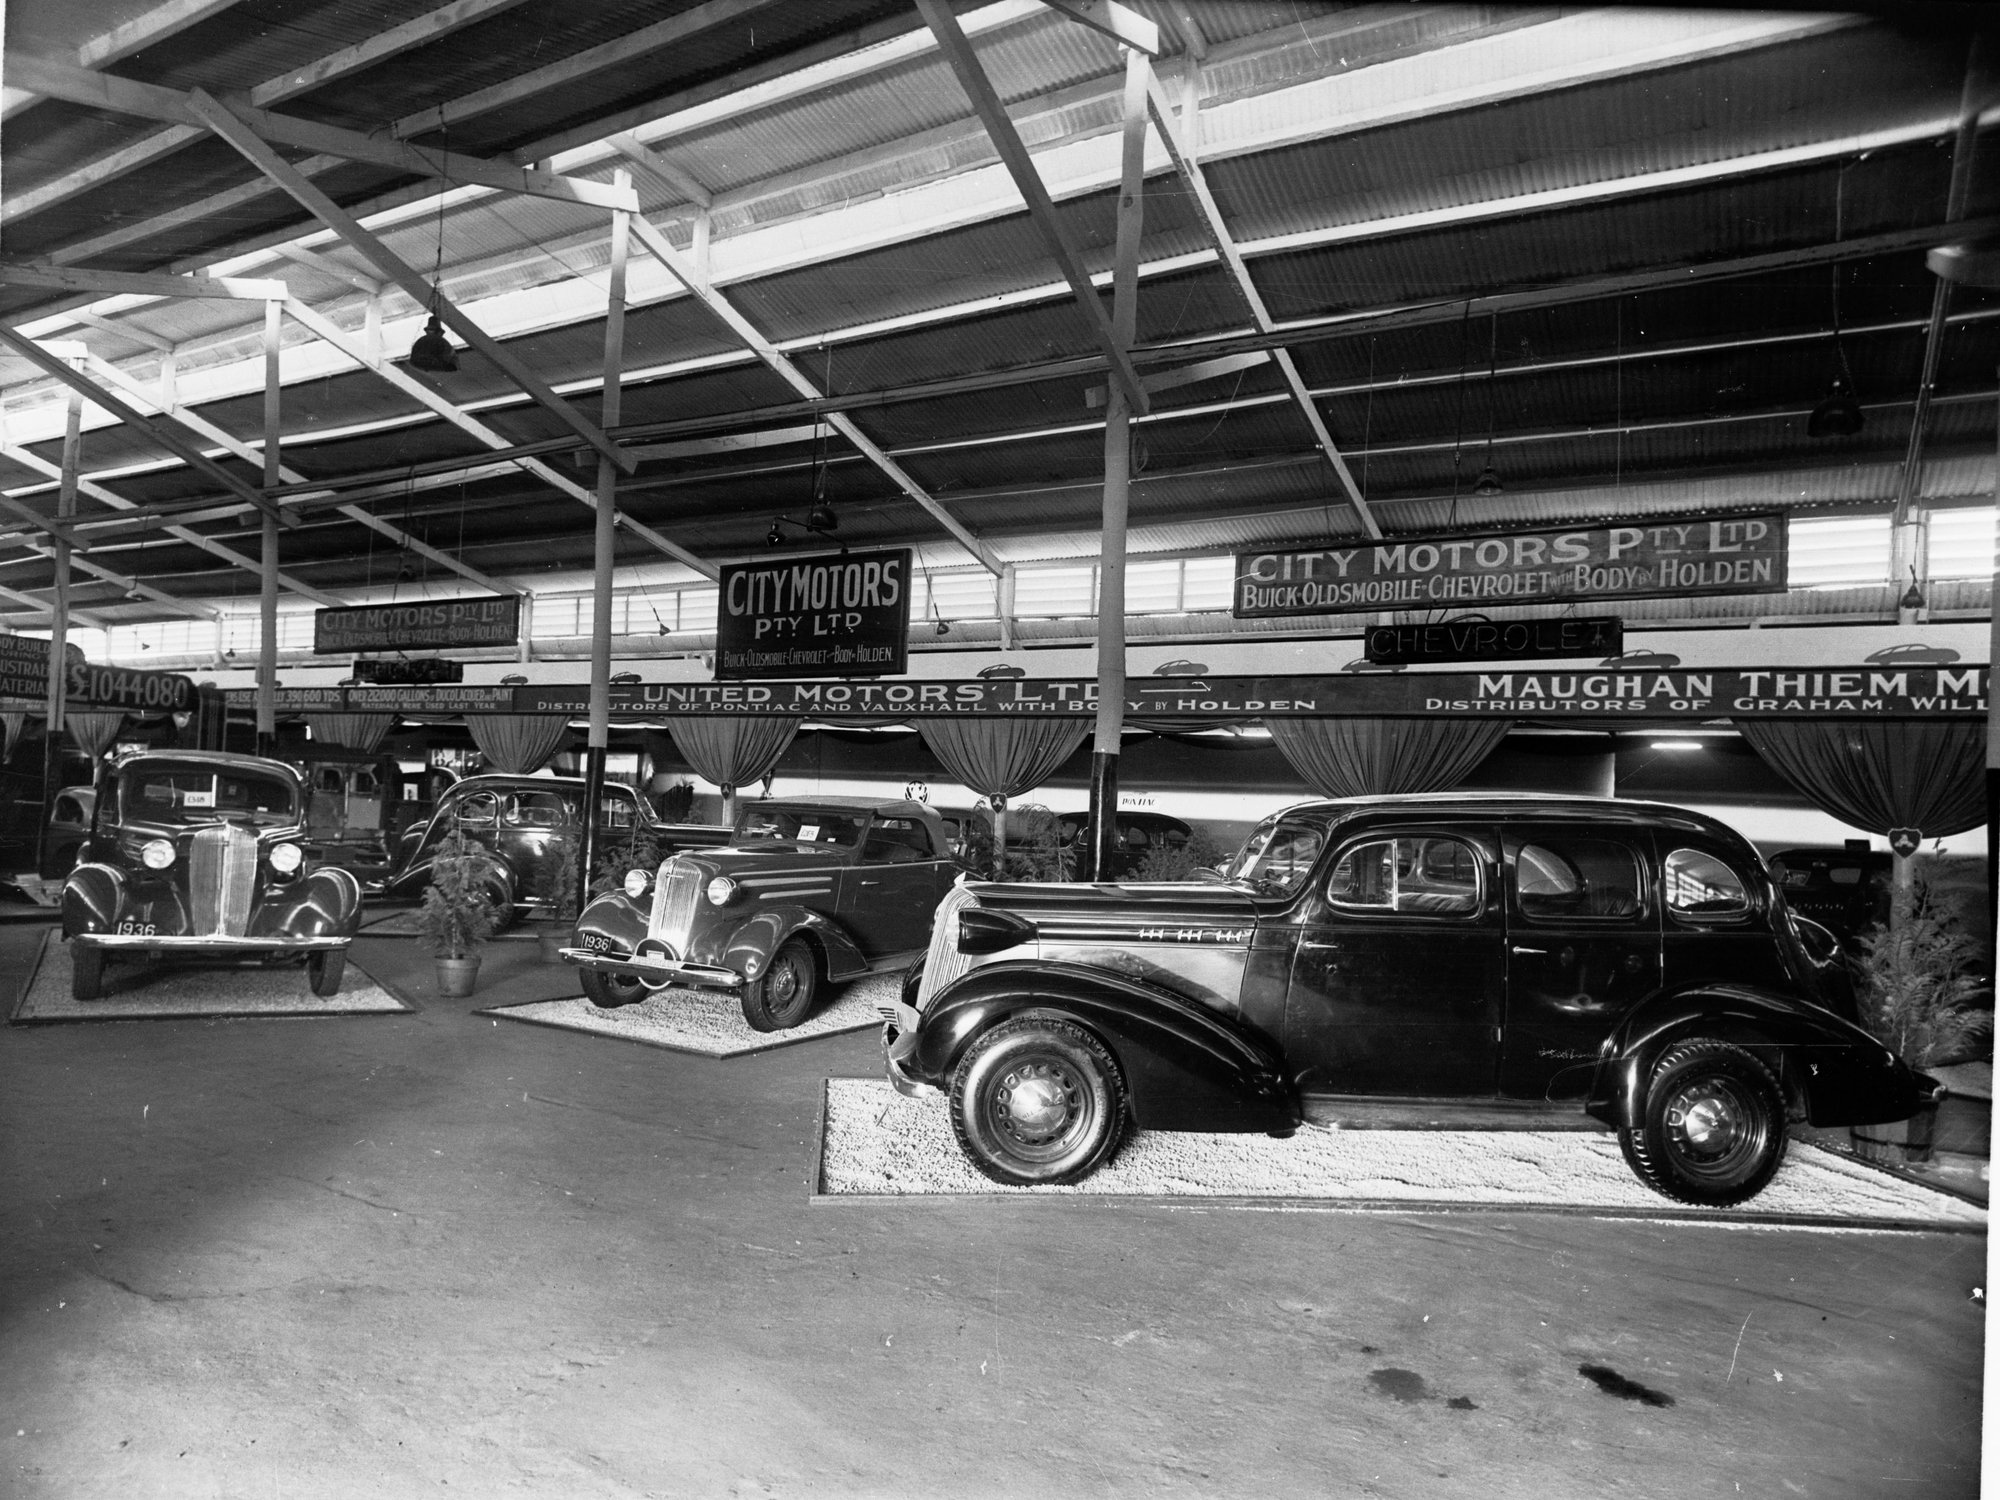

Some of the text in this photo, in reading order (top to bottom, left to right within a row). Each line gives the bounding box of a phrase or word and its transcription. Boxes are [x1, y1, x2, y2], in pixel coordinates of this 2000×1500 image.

[1250, 549, 1361, 582] CITY
[1373, 533, 1592, 575] MOTORS
[1574, 563, 1639, 593] BODY
[1659, 557, 1772, 588] HOLDEN
[727, 560, 900, 617] CITY MOTORS
[323, 611, 362, 630] CITY
[365, 605, 447, 629] MOTORS
[834, 644, 853, 664] BODY
[643, 685, 772, 703] UNITED
[794, 685, 985, 702] MOTORS
[1478, 674, 1713, 698] MAUGHAN
[1739, 671, 1908, 698] THIEM
[537, 698, 1317, 712] DISTRIUTORS OF PONTIAC AND VAUXHALL WITH BOY BY HOLDEN
[1425, 698, 1647, 711] DISTRIBUTORS
[1669, 700, 1712, 711] OF
[116, 921, 156, 937] 1936
[584, 933, 610, 951] 1936
